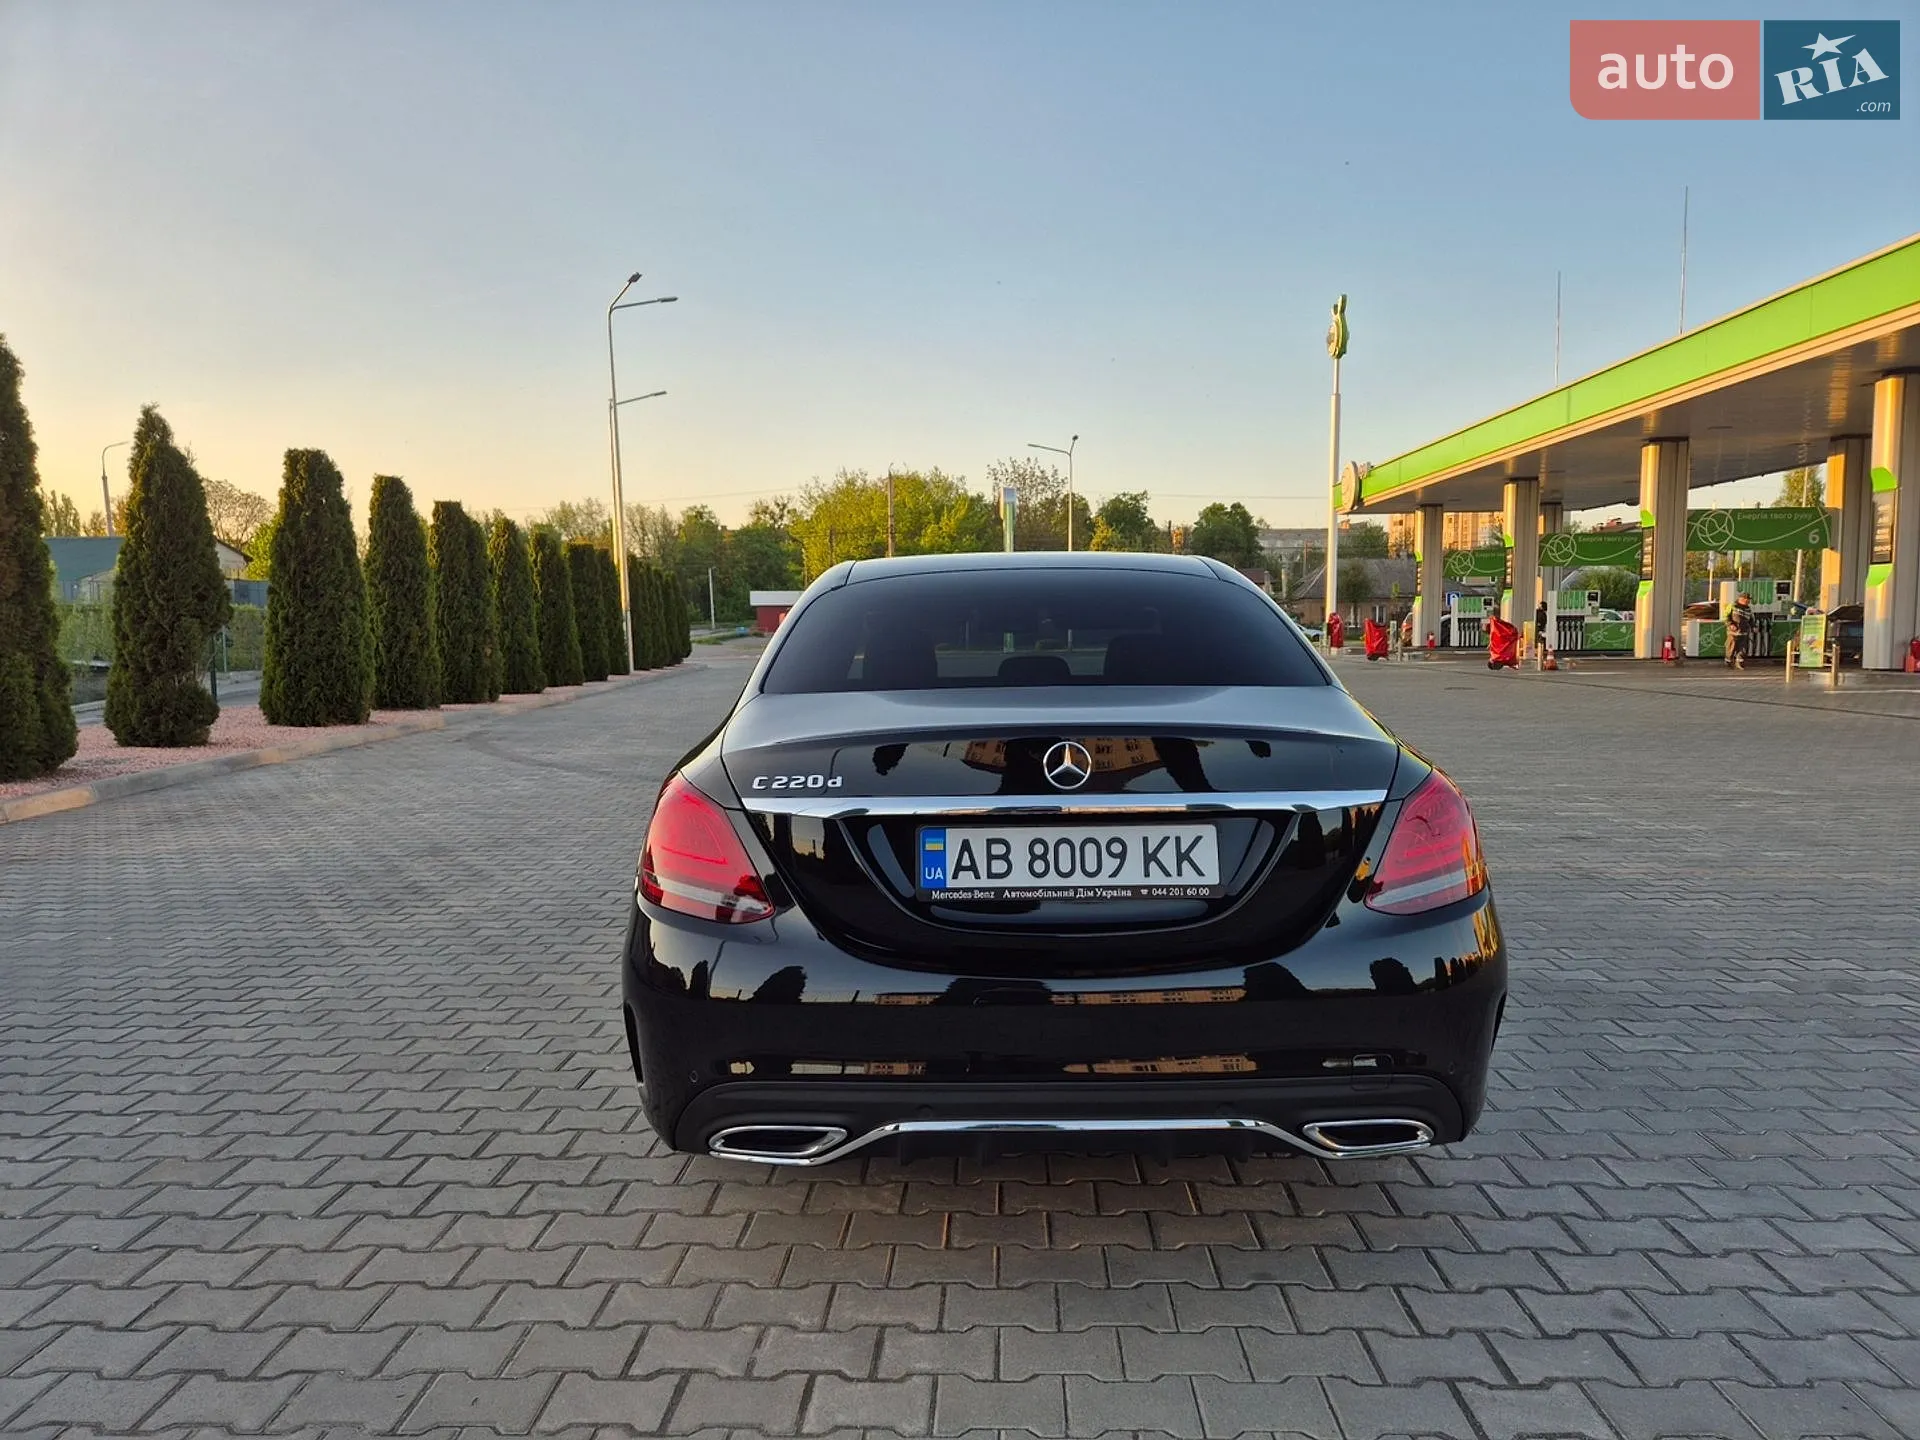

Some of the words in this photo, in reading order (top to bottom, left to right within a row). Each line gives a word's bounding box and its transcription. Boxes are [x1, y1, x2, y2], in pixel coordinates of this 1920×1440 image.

[1808, 529, 1820, 544] 6
[951, 838, 1013, 880] AB
[1028, 836, 1128, 879] 8009
[1142, 835, 1206, 878] KK
[925, 867, 944, 880] UA
[1002, 889, 1074, 898] Автомобільний
[1076, 888, 1093, 898] Дім
[1095, 888, 1132, 898] Україна
[1152, 887, 1167, 896] 044
[1169, 887, 1184, 896] 201
[1186, 887, 1197, 896] 60
[1198, 887, 1210, 896] 00
